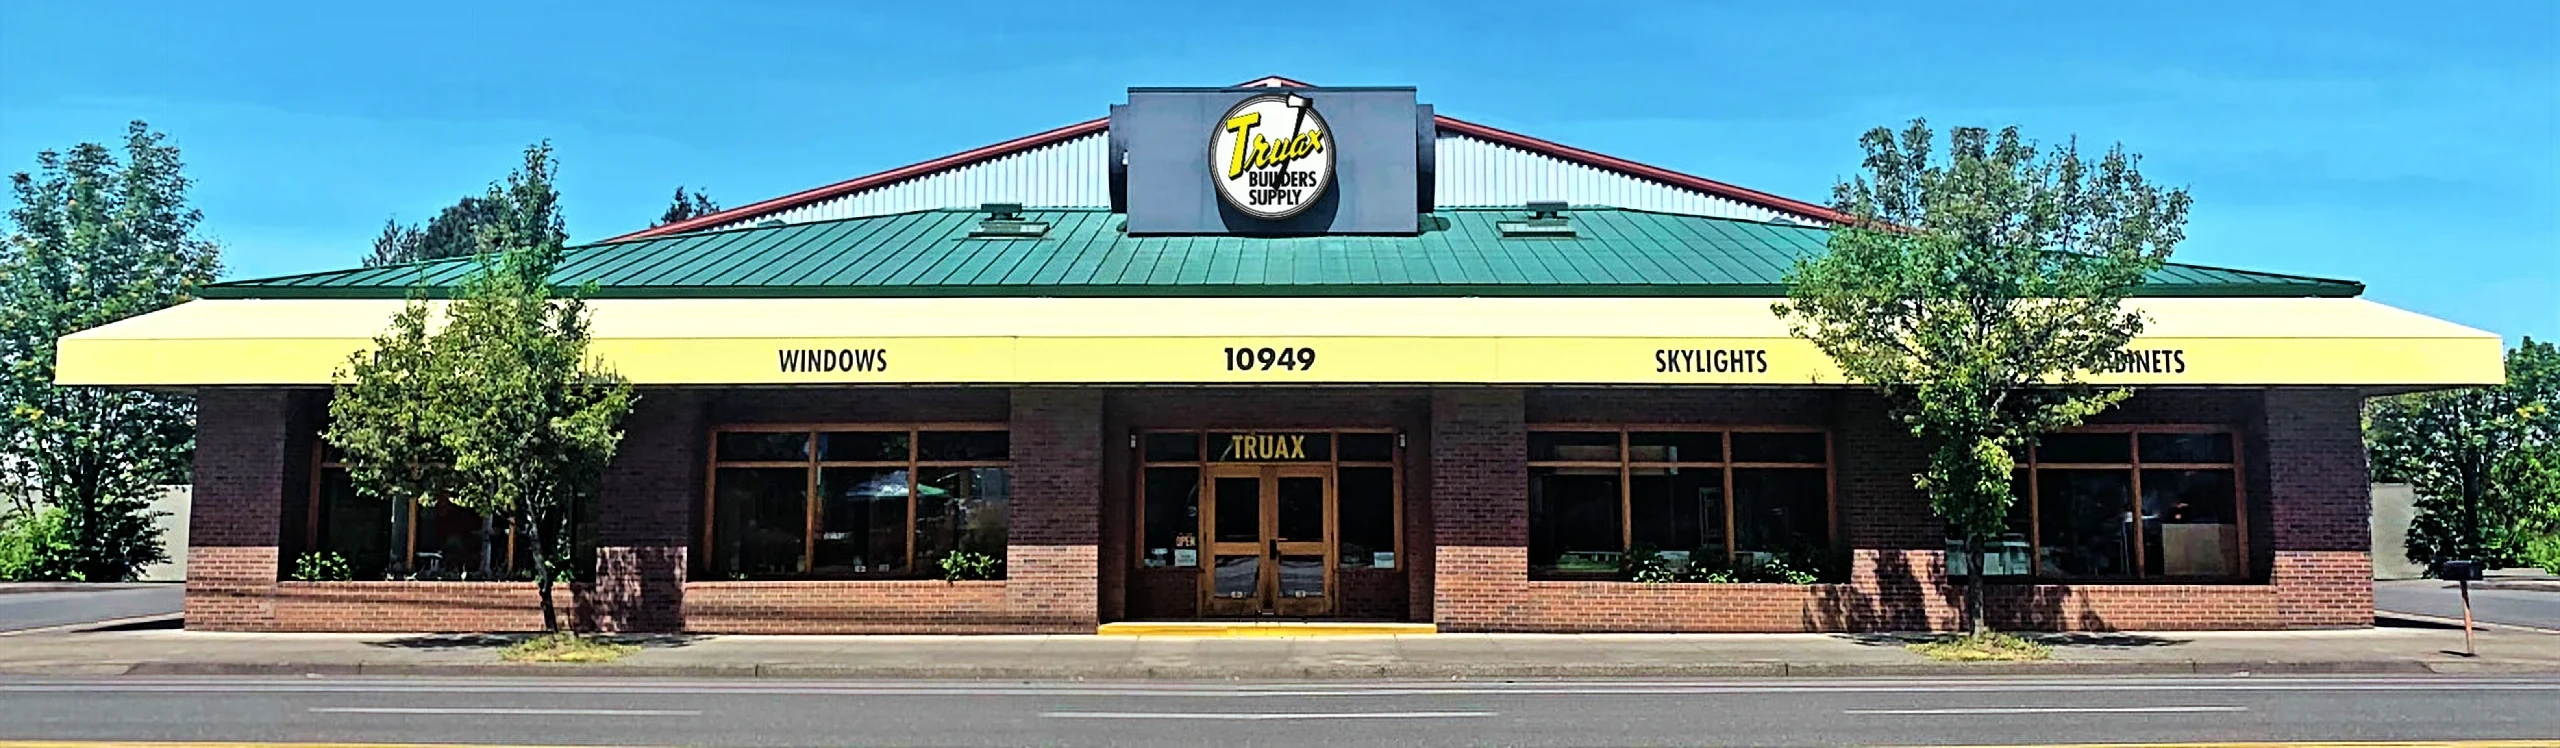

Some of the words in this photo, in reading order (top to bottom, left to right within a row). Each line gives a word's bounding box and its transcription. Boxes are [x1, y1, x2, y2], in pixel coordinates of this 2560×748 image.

[1226, 111, 1323, 181] Truax
[1249, 189, 1302, 205] SUPPLY
[778, 348, 887, 373] WINDOWS
[1224, 347, 1316, 371] 10949
[1655, 349, 1768, 373] SKYLIGHTS
[1231, 434, 1306, 459] TRUAX
